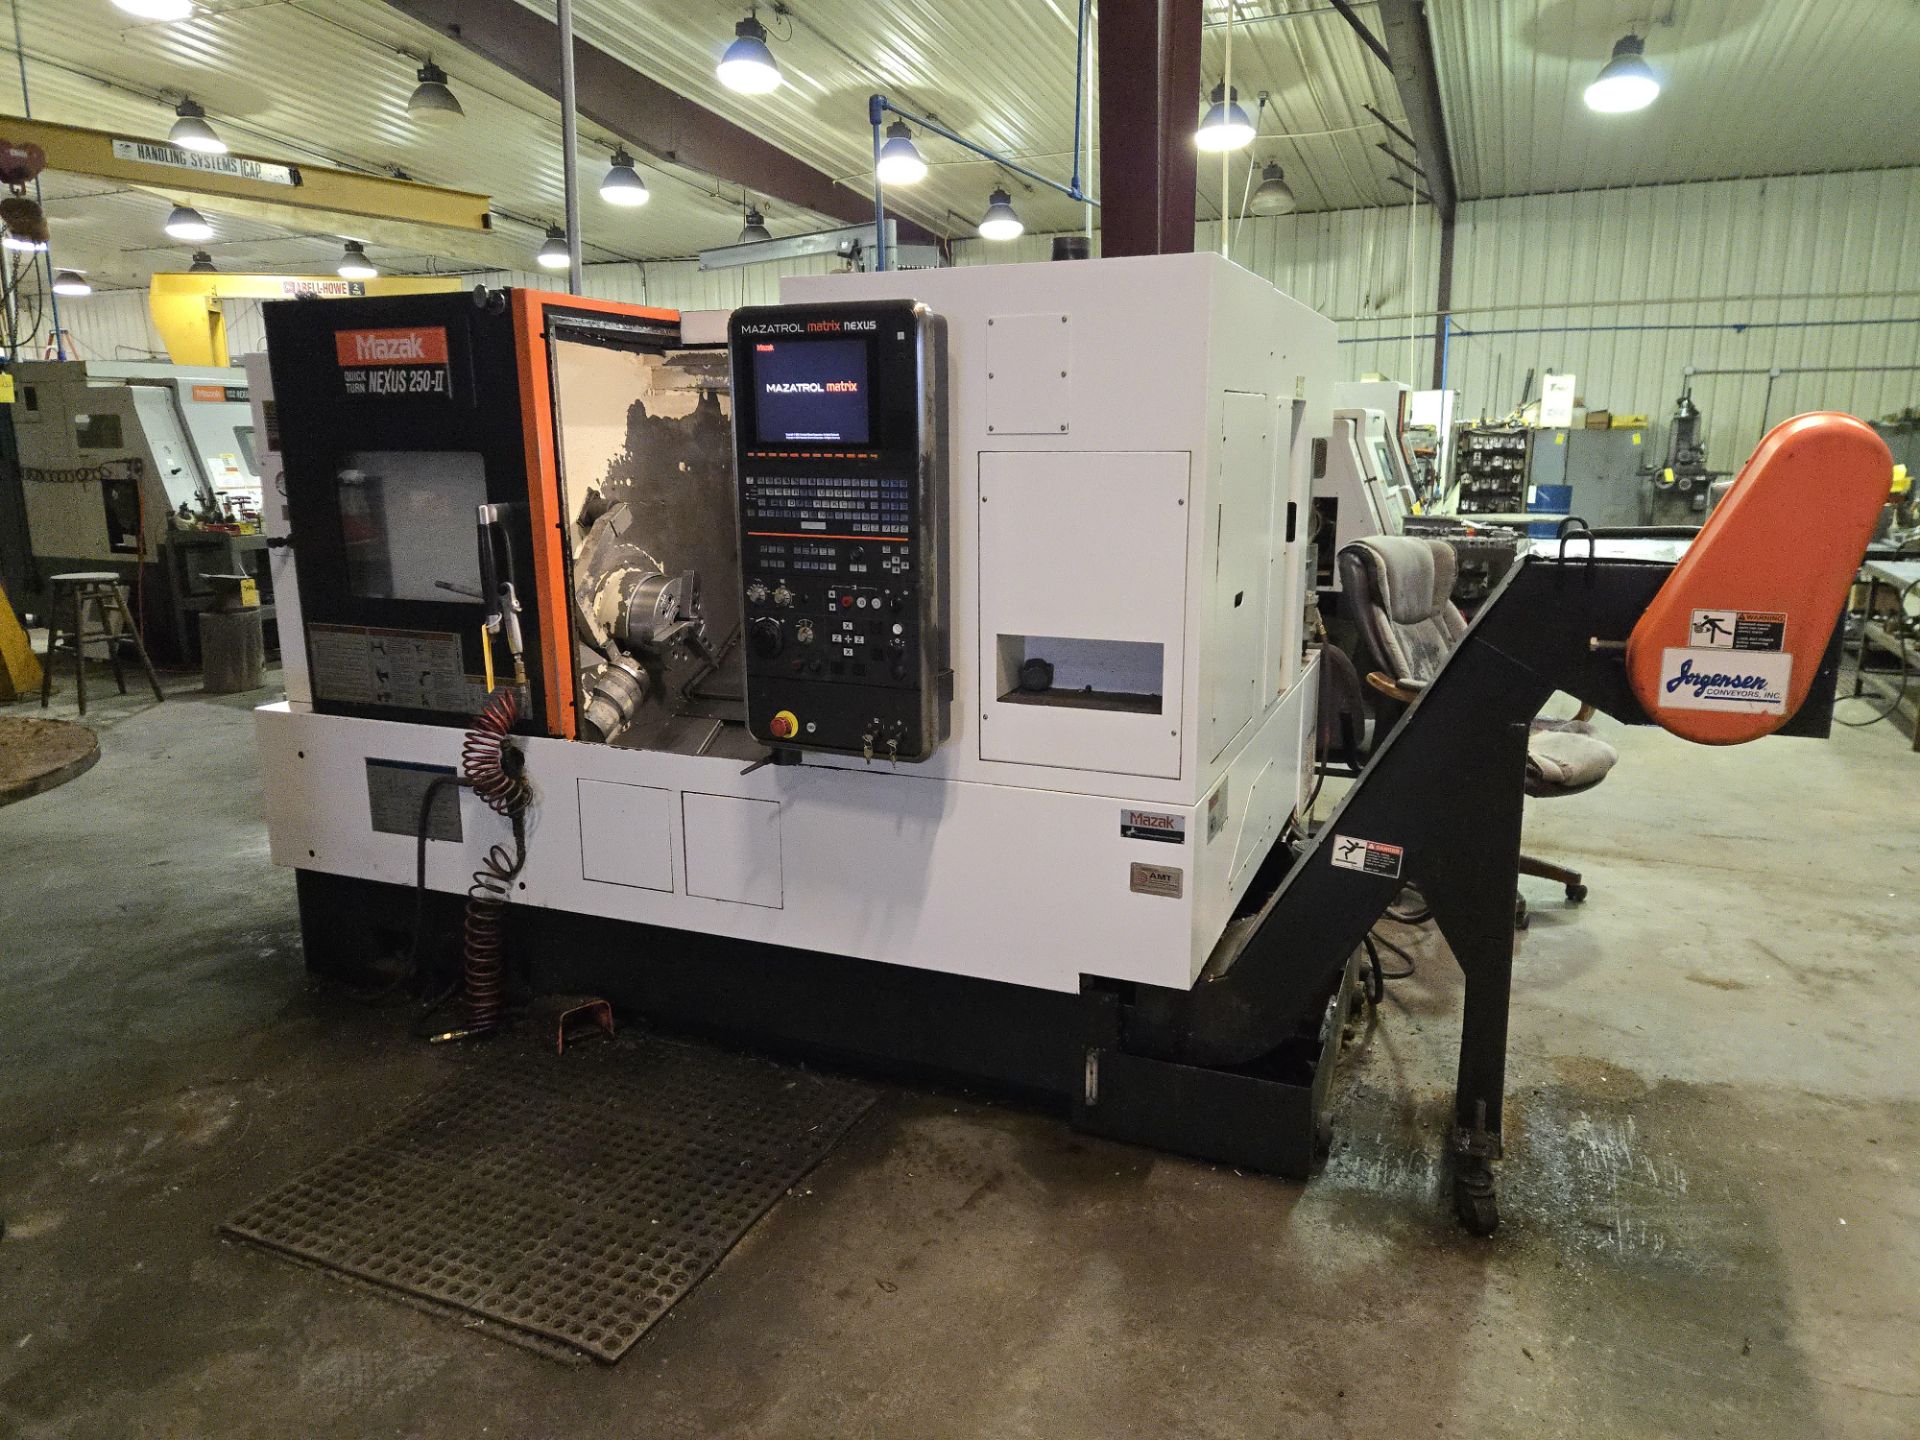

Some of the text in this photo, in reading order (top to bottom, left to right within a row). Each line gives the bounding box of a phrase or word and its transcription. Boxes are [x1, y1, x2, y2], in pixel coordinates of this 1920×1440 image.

[136, 144, 187, 166] HANDLING
[190, 152, 238, 174] SYSTEMS
[741, 323, 805, 335] MAZATROL
[807, 320, 841, 332] matrix
[355, 332, 425, 361] Mazak
[368, 367, 407, 395] NEXUS
[766, 380, 858, 393] MAZATROL matrix
[1666, 658, 1769, 698] Jorgensen
[1706, 688, 1782, 700] CONVEYORS, INC.
[1129, 811, 1175, 830] Mazak
[1149, 871, 1173, 881] AMT
